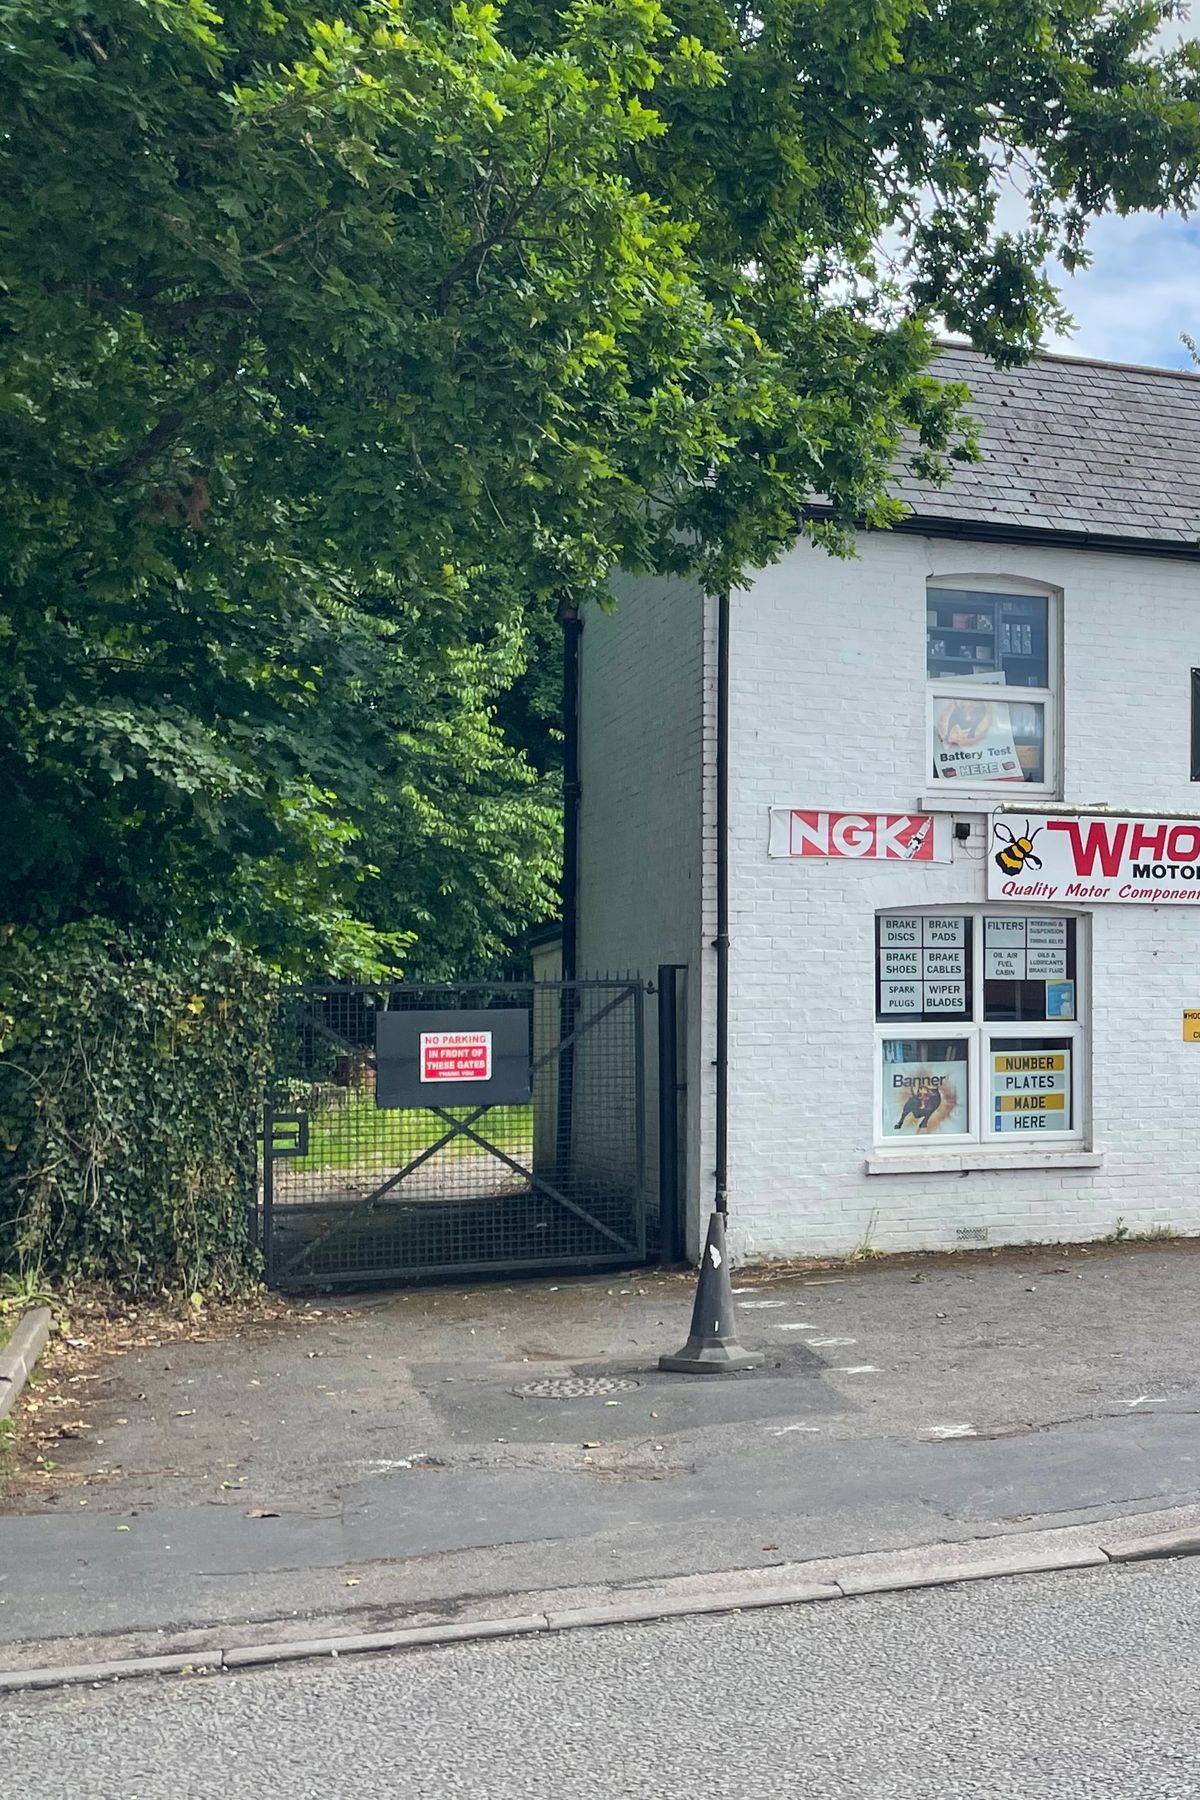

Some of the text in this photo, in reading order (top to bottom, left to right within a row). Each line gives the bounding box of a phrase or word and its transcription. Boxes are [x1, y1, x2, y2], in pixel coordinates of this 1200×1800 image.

[940, 746, 1012, 762] Battery Test
[959, 762, 999, 776] HERE
[790, 810, 912, 858] NGK
[1002, 881, 1058, 899] Quality
[1065, 883, 1110, 898] Motor
[886, 920, 917, 929] BRAKE
[928, 920, 959, 929] BRAKE
[987, 921, 1024, 930] FILTERS
[887, 933, 915, 941] DISCS
[931, 932, 957, 941] PADS
[886, 953, 917, 962] BRAKE
[928, 953, 959, 962] BRAKE
[886, 965, 917, 974] SHOES
[927, 965, 962, 974] CABLES
[889, 986, 915, 994] SPARK
[929, 985, 960, 994] WIPER
[889, 1000, 915, 1008] PLUGS
[926, 998, 963, 1007] BLADES
[425, 1035, 486, 1044] NO PARKING
[428, 1048, 483, 1058] IN FRONT OF
[426, 1060, 485, 1070] THESE GATES
[1005, 1057, 1055, 1070] NUMBER
[893, 1074, 946, 1088] Banner
[1005, 1075, 1055, 1089] PLATES
[1014, 1095, 1046, 1109] MADE
[1014, 1115, 1046, 1129] HERE
